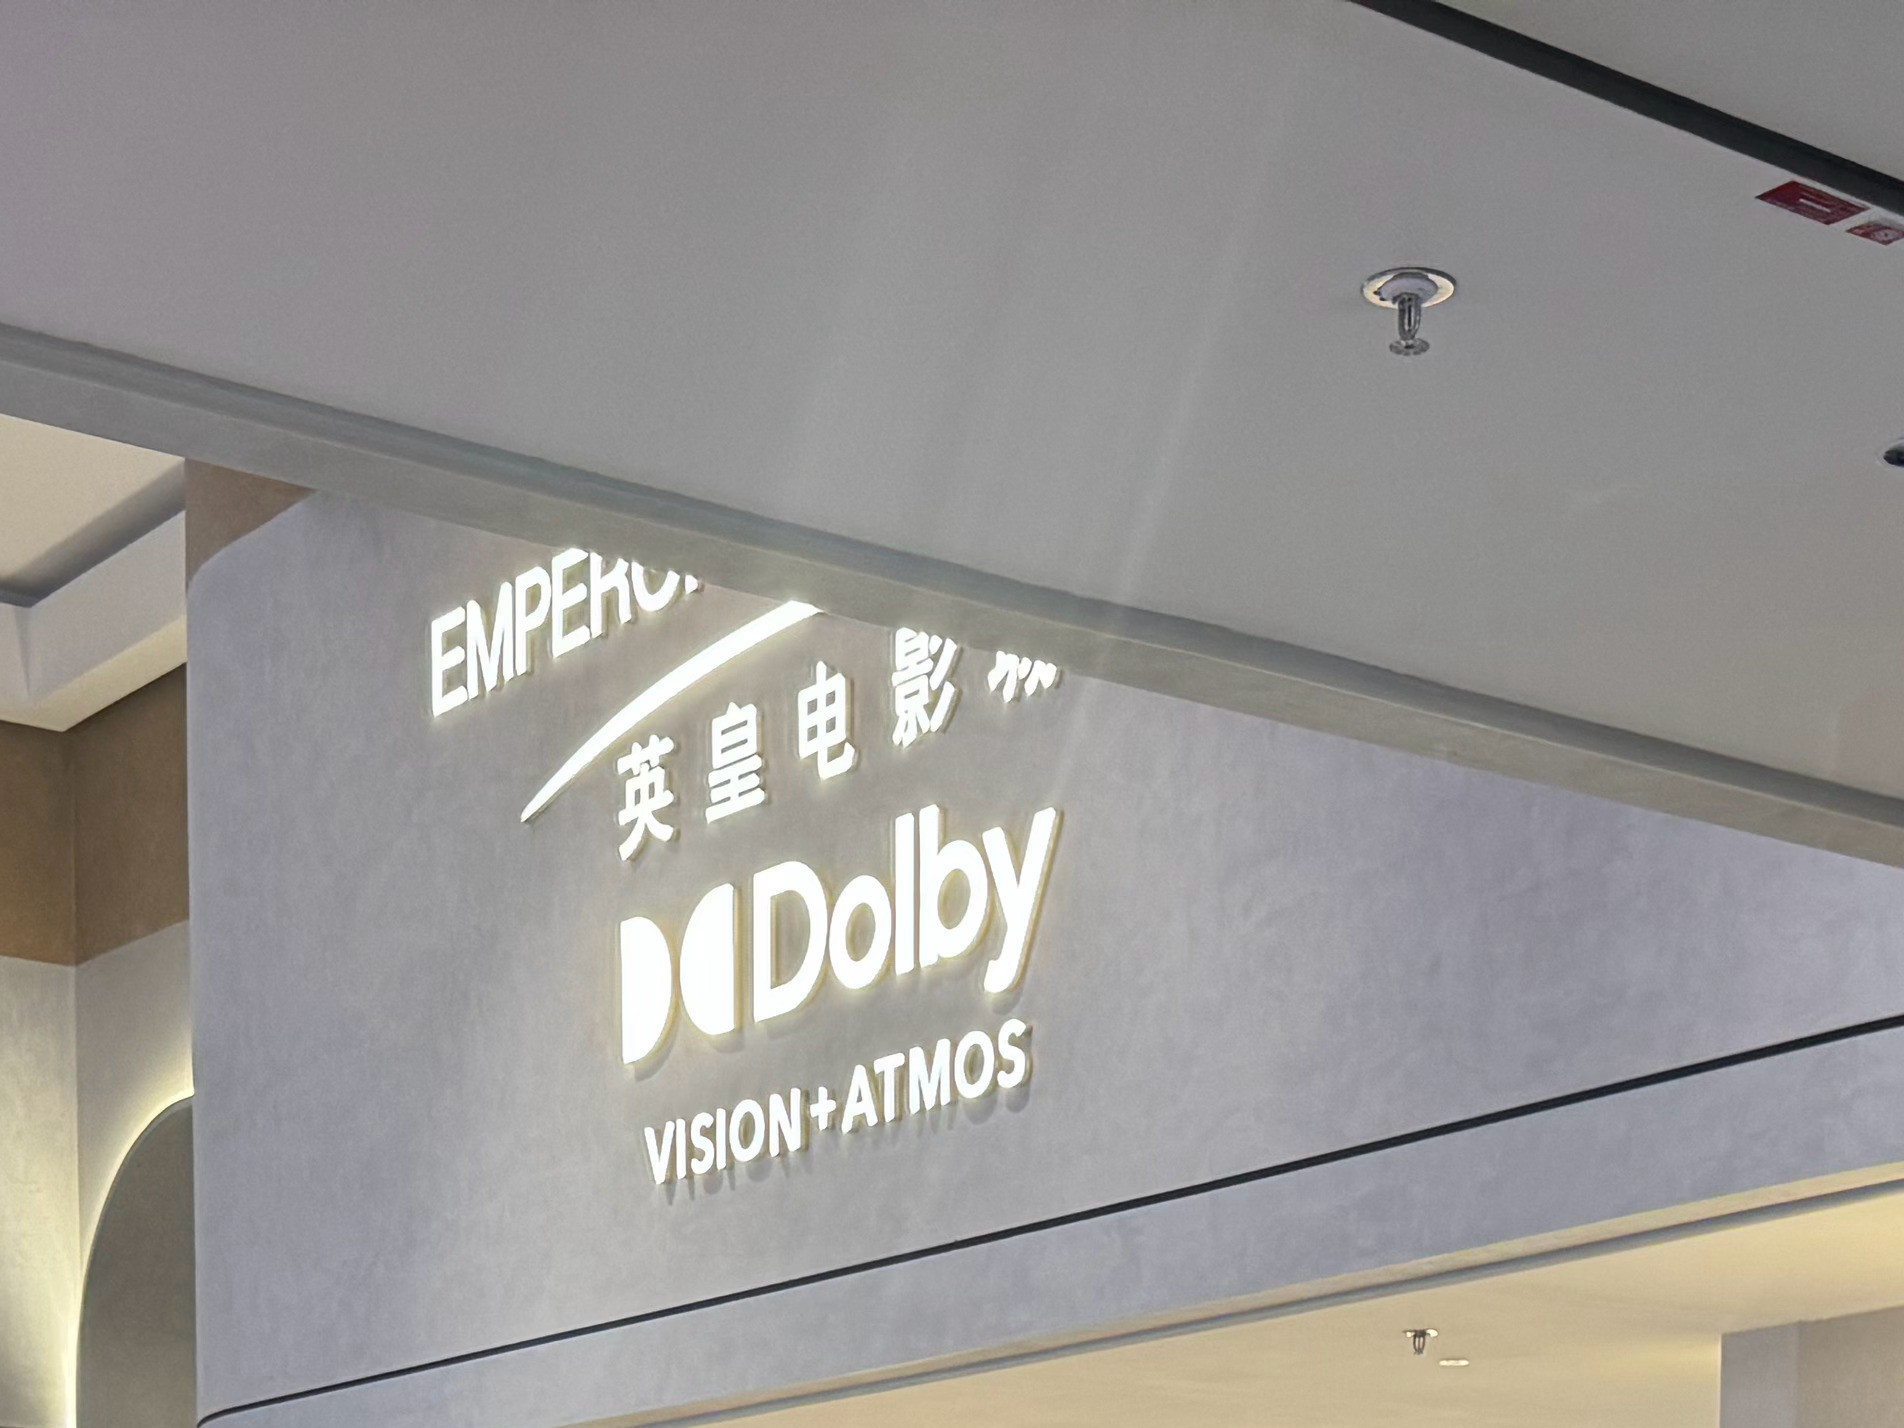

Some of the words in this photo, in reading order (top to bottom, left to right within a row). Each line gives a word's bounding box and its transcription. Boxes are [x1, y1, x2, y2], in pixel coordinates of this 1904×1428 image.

[430, 547, 699, 718] EMPERO
[751, 804, 1058, 1023] Dolby
[645, 1018, 1029, 1185] VISION+ATMOS
